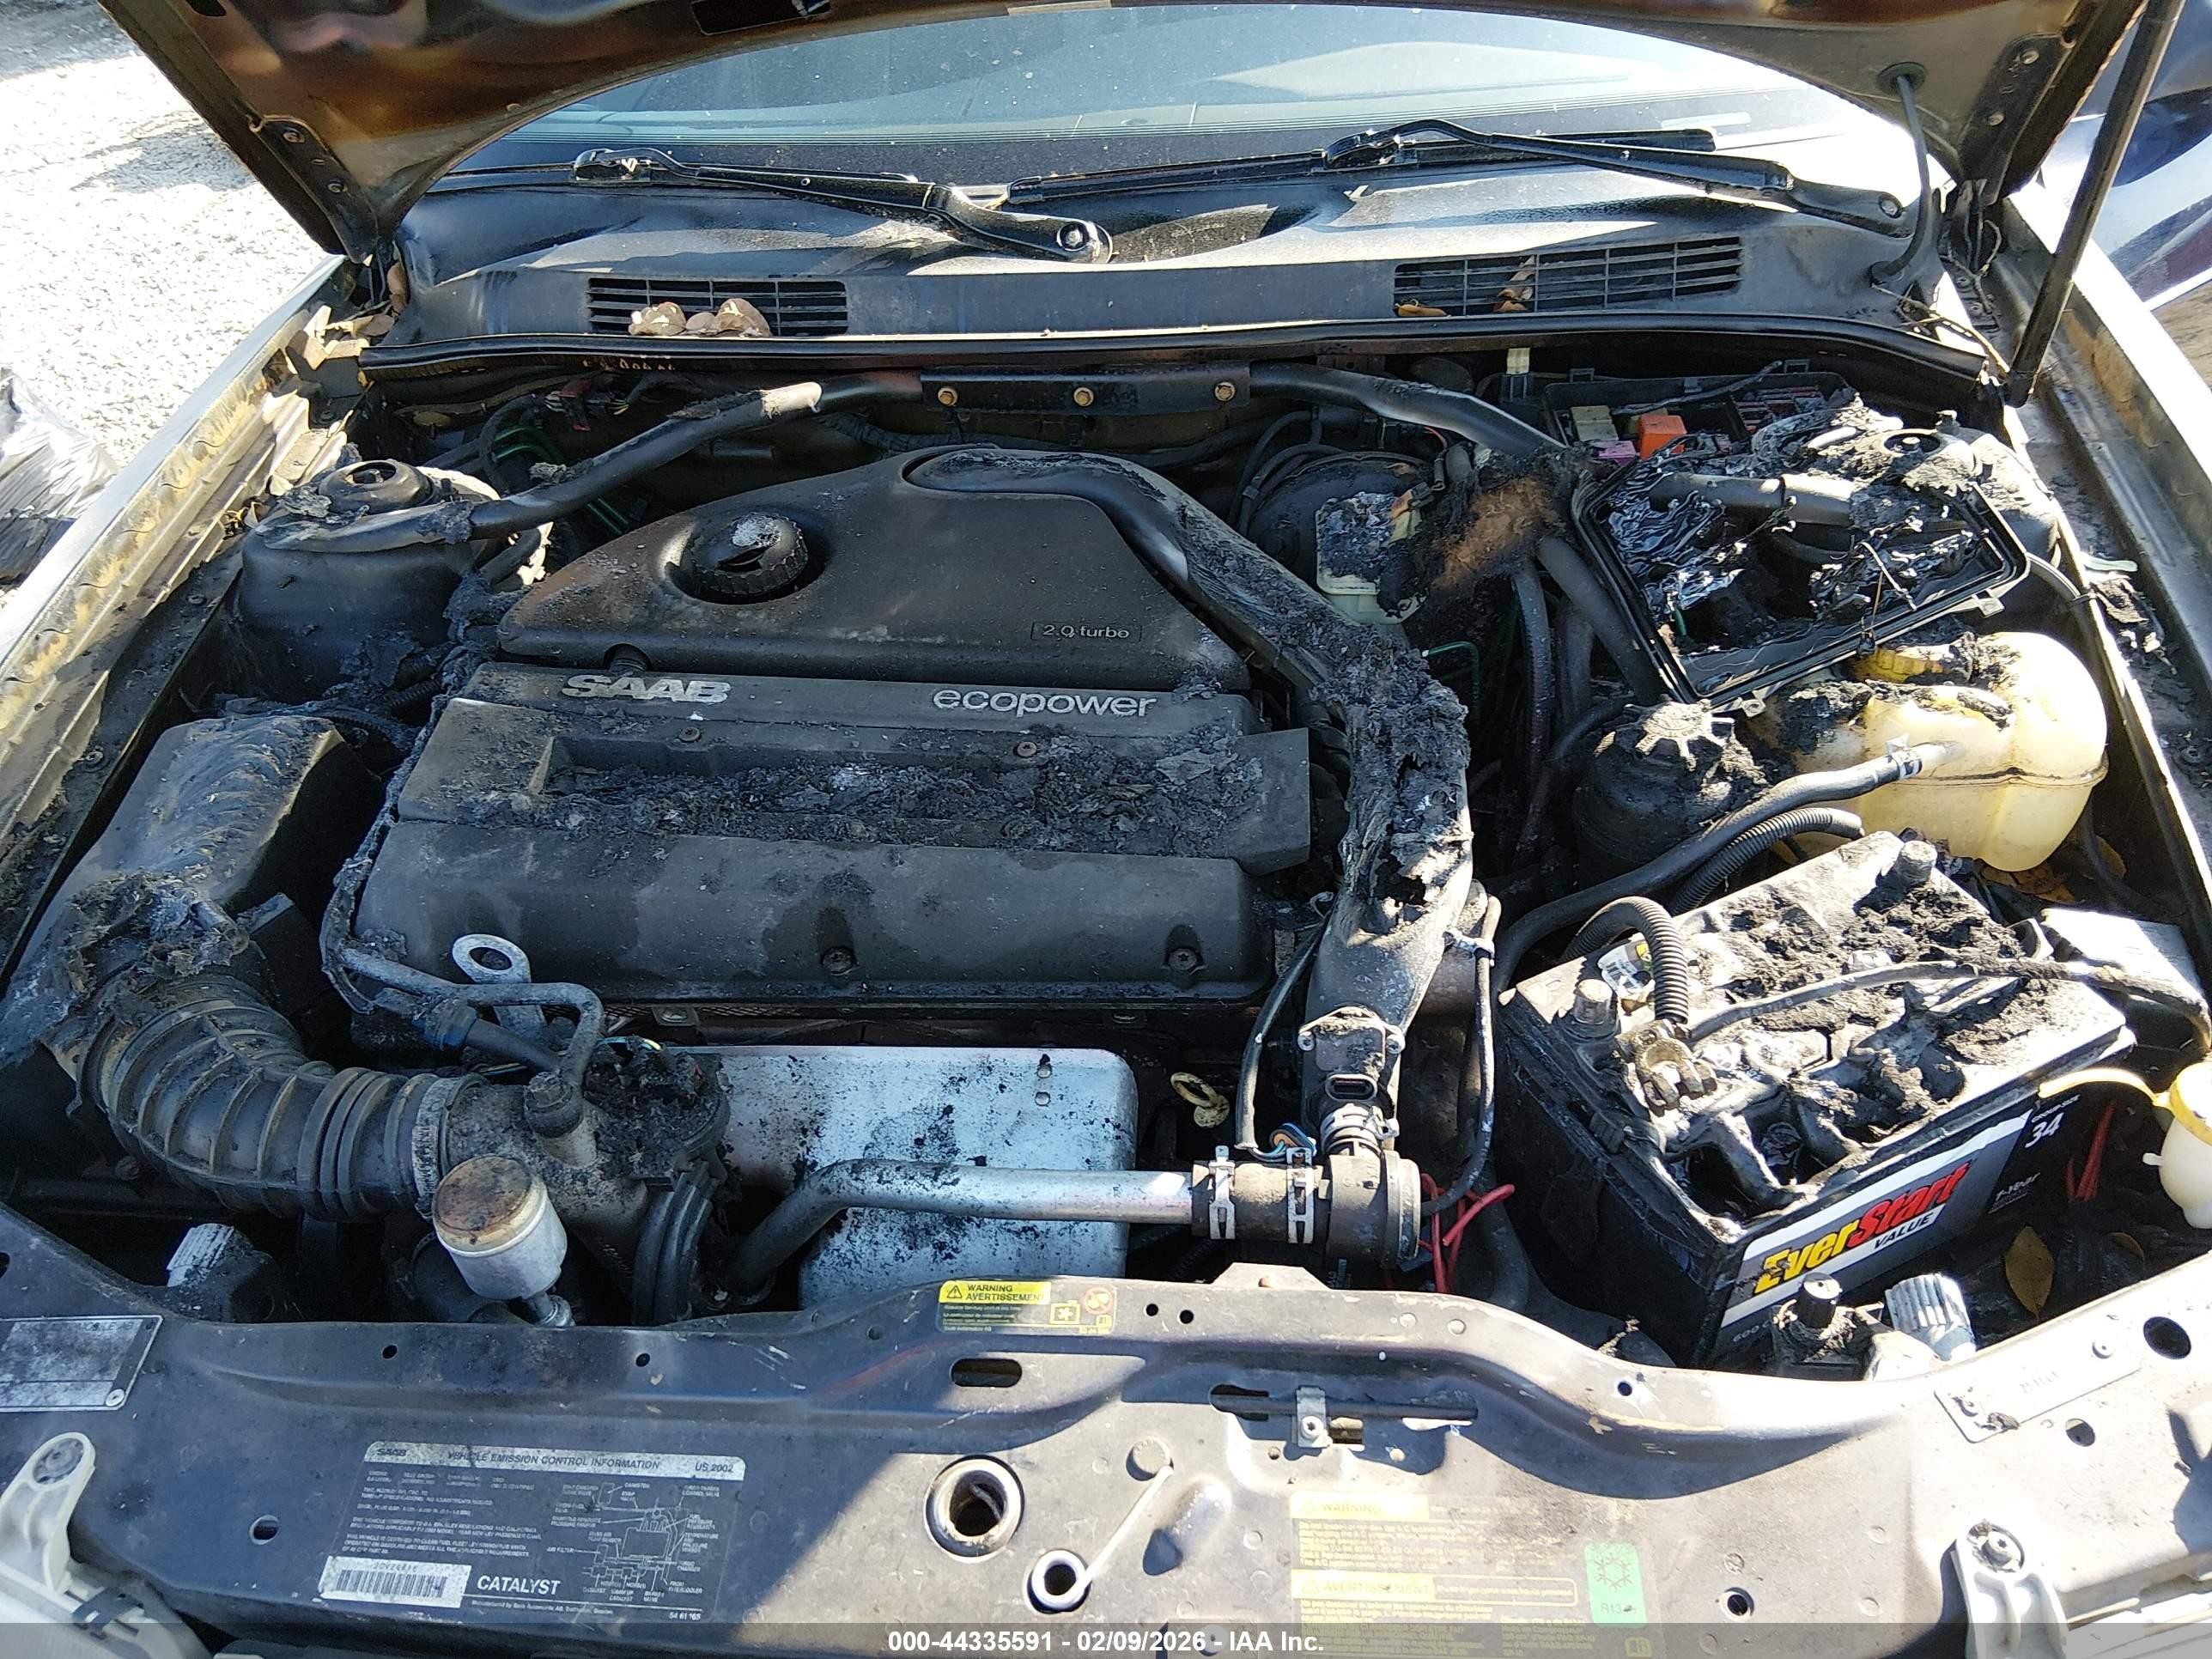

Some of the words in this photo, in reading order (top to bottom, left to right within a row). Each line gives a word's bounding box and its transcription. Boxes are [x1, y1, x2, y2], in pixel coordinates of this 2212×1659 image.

[1042, 623, 1075, 637] 2.0
[1079, 625, 1130, 638] turbo
[562, 674, 731, 703] SAAB
[933, 689, 1158, 718] ecopower
[2025, 1112, 2064, 1148] 34
[1874, 1212, 1935, 1249] VALUE
[490, 1453, 538, 1465] EMISSION
[541, 1455, 588, 1467] CONTROL
[591, 1457, 660, 1470] INFORMATION
[695, 1462, 708, 1471] US
[711, 1463, 734, 1474] 2002
[477, 1575, 562, 1595] CATALYST
